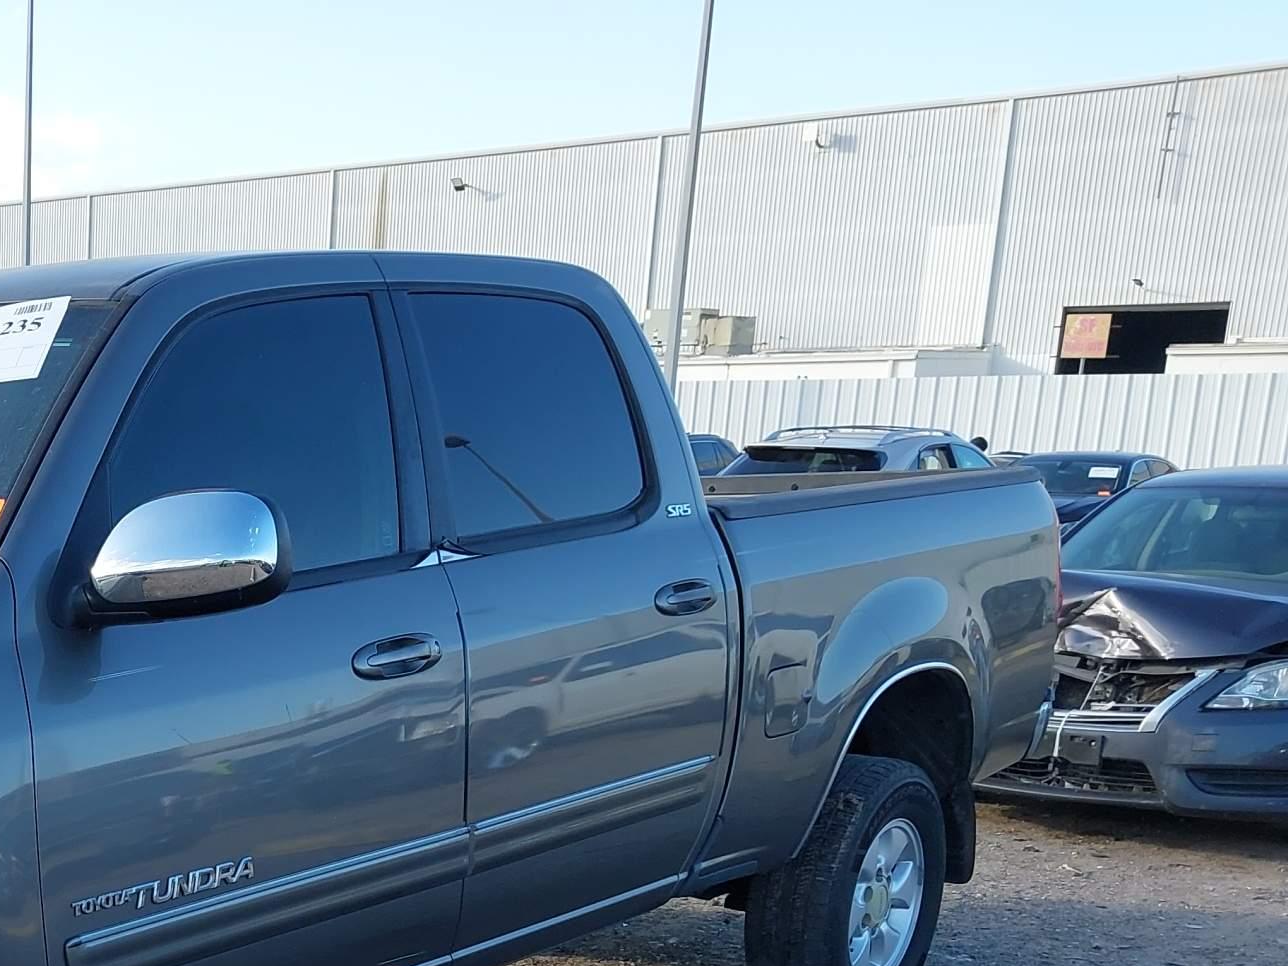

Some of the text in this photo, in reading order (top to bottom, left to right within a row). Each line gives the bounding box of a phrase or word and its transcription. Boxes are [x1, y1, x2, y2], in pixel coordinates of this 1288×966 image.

[666, 503, 692, 517] SR5
[71, 856, 255, 917] TOYOTA TUNDRA
